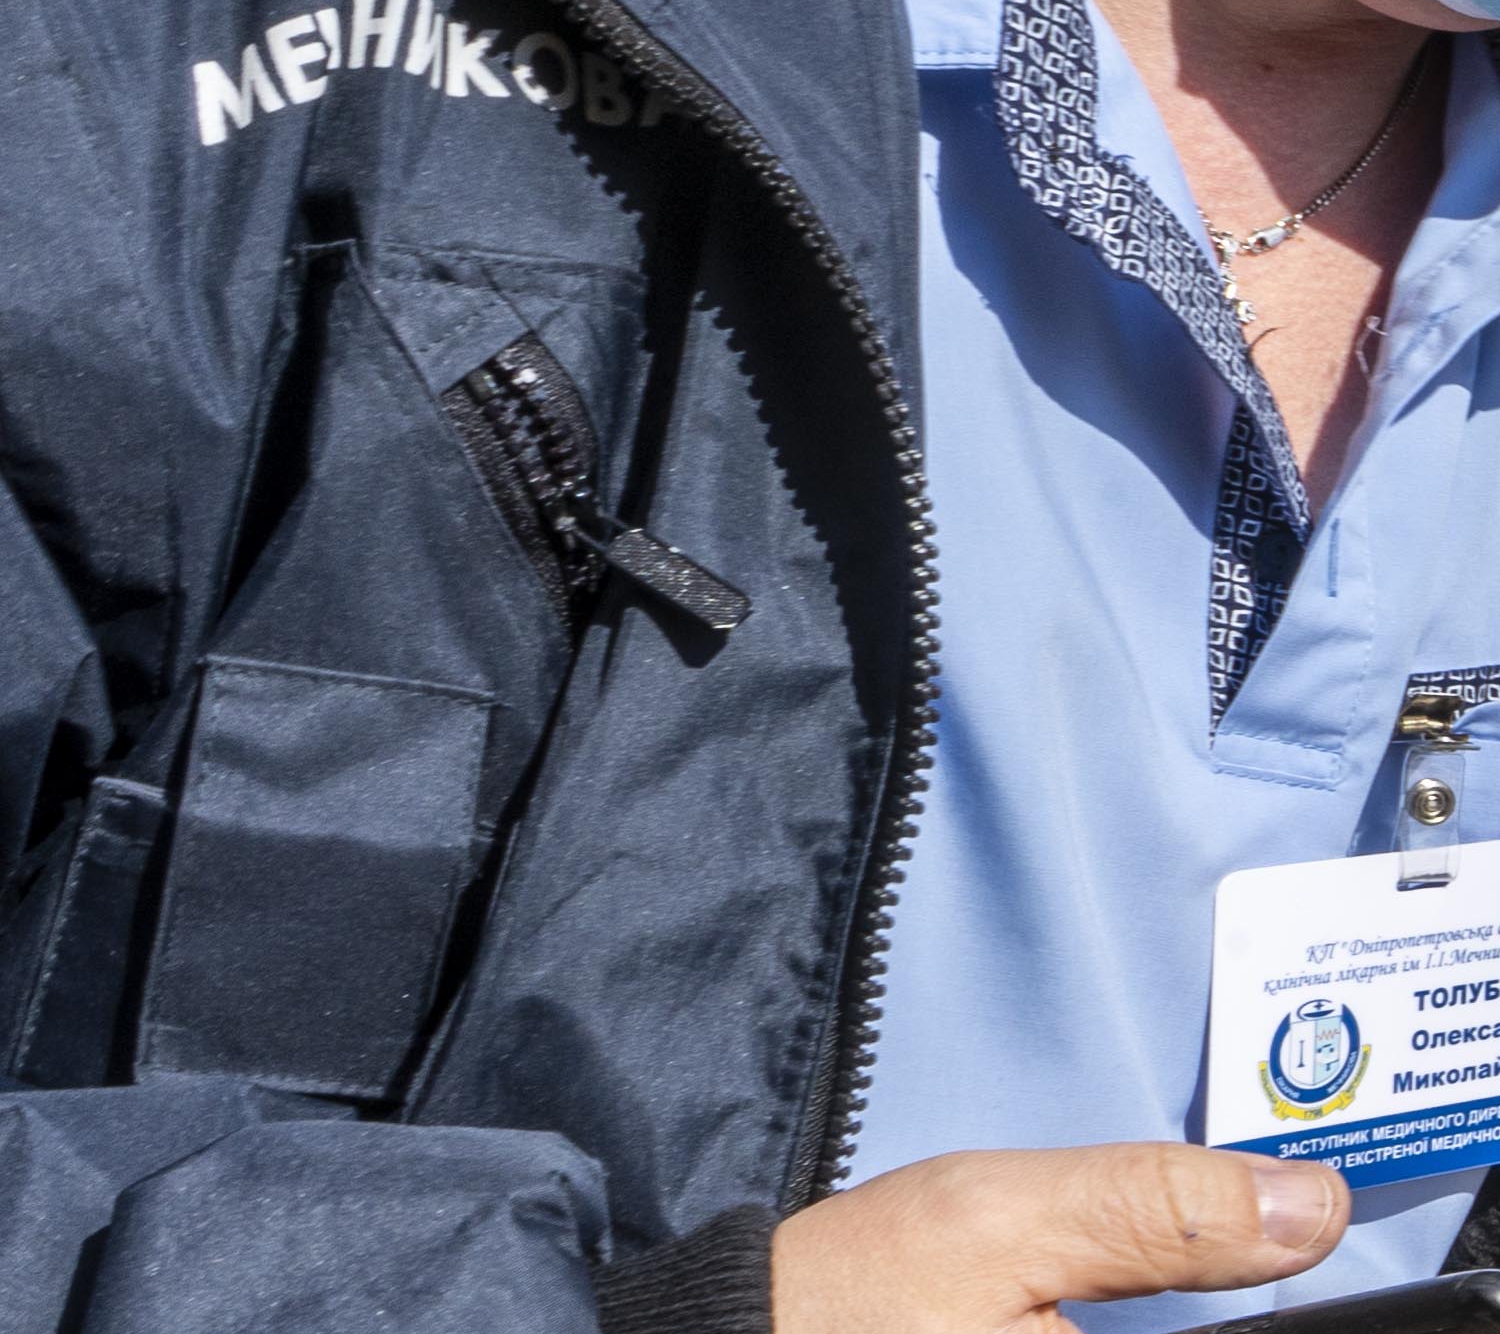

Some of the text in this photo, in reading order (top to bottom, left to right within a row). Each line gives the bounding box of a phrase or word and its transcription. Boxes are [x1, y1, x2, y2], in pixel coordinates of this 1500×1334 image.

[1263, 970, 1331, 996] клінічна
[1336, 961, 1398, 985] лікарня
[1278, 1128, 1369, 1160] ЗАСТУПНИК
[1372, 1111, 1465, 1141] МЕДИЧНОГО
[1345, 1138, 1428, 1169] ЕКСТРЕНОЇ
